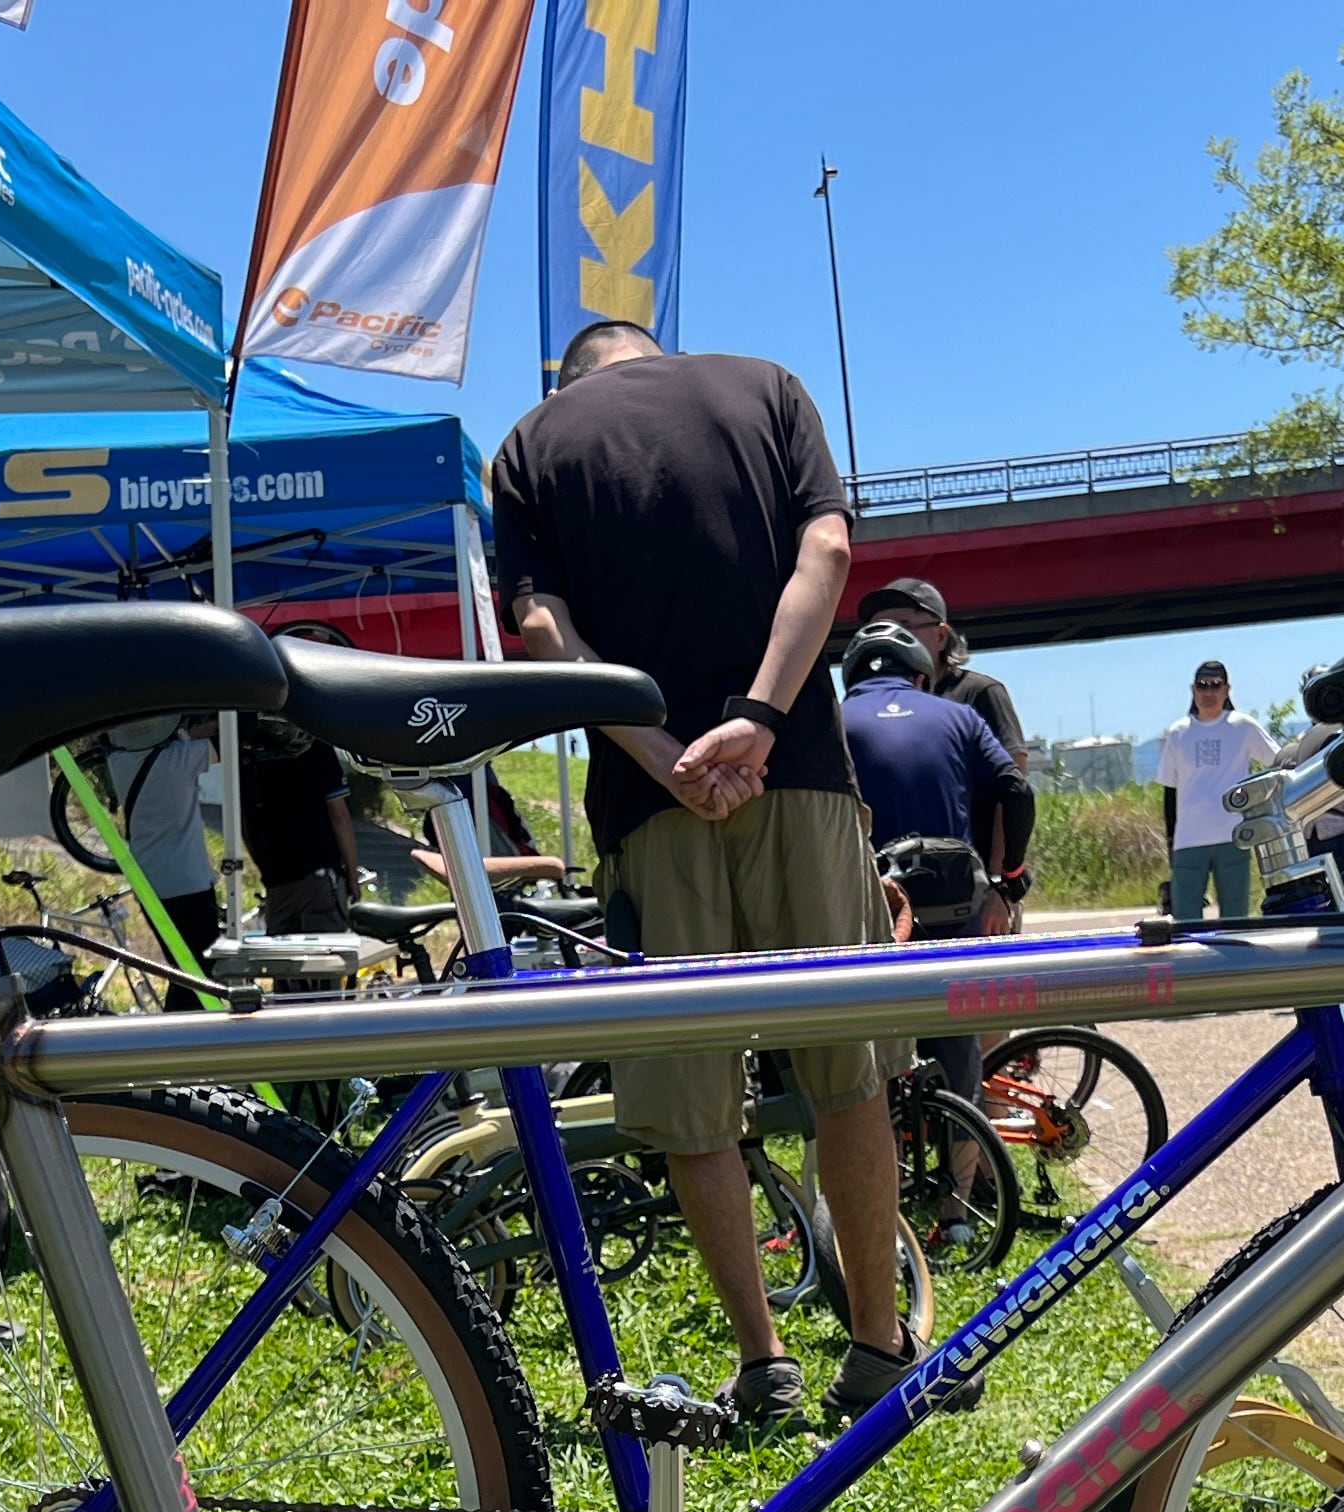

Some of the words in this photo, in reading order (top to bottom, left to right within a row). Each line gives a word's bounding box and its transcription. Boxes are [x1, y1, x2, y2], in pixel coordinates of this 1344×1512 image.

[126, 256, 217, 353] pacific-cycles.com
[309, 300, 443, 339] Pacific
[371, 339, 434, 359] Cycles
